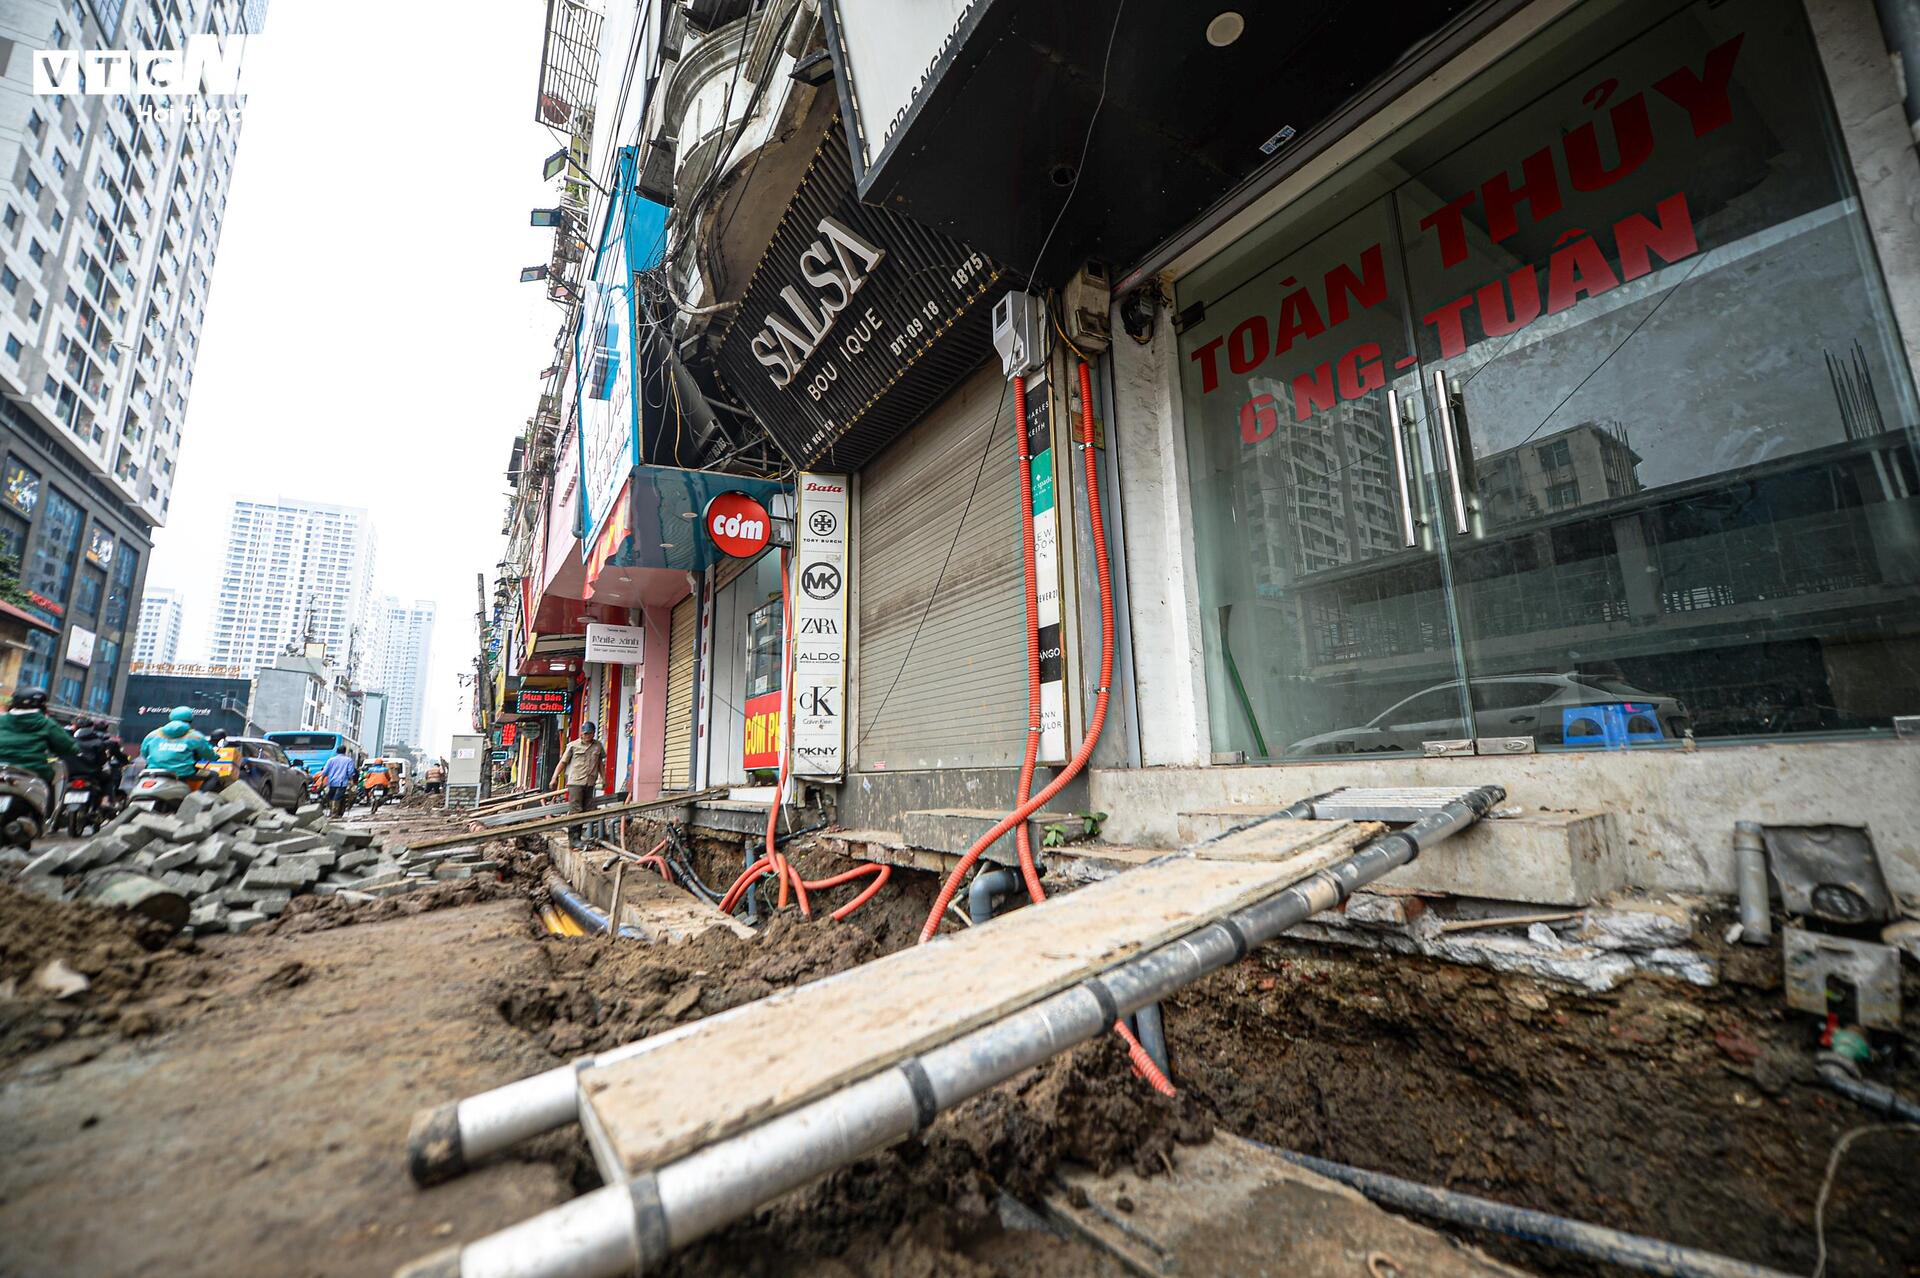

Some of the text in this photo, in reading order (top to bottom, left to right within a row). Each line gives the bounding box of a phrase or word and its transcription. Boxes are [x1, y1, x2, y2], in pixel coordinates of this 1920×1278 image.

[1190, 32, 1745, 394] TOÀN THỦY
[951, 252, 983, 290] 1875
[751, 215, 887, 392] SALSA
[1240, 395, 1278, 445] 6
[804, 482, 844, 494] Bata
[713, 513, 763, 540] cơm
[1037, 528, 1053, 542] EW
[1034, 536, 1056, 552] OOK
[807, 572, 836, 590] MK
[801, 617, 839, 634] ZARA
[800, 652, 840, 661] ALDO
[745, 712, 766, 756] CƠM
[798, 746, 837, 756] DKNY
